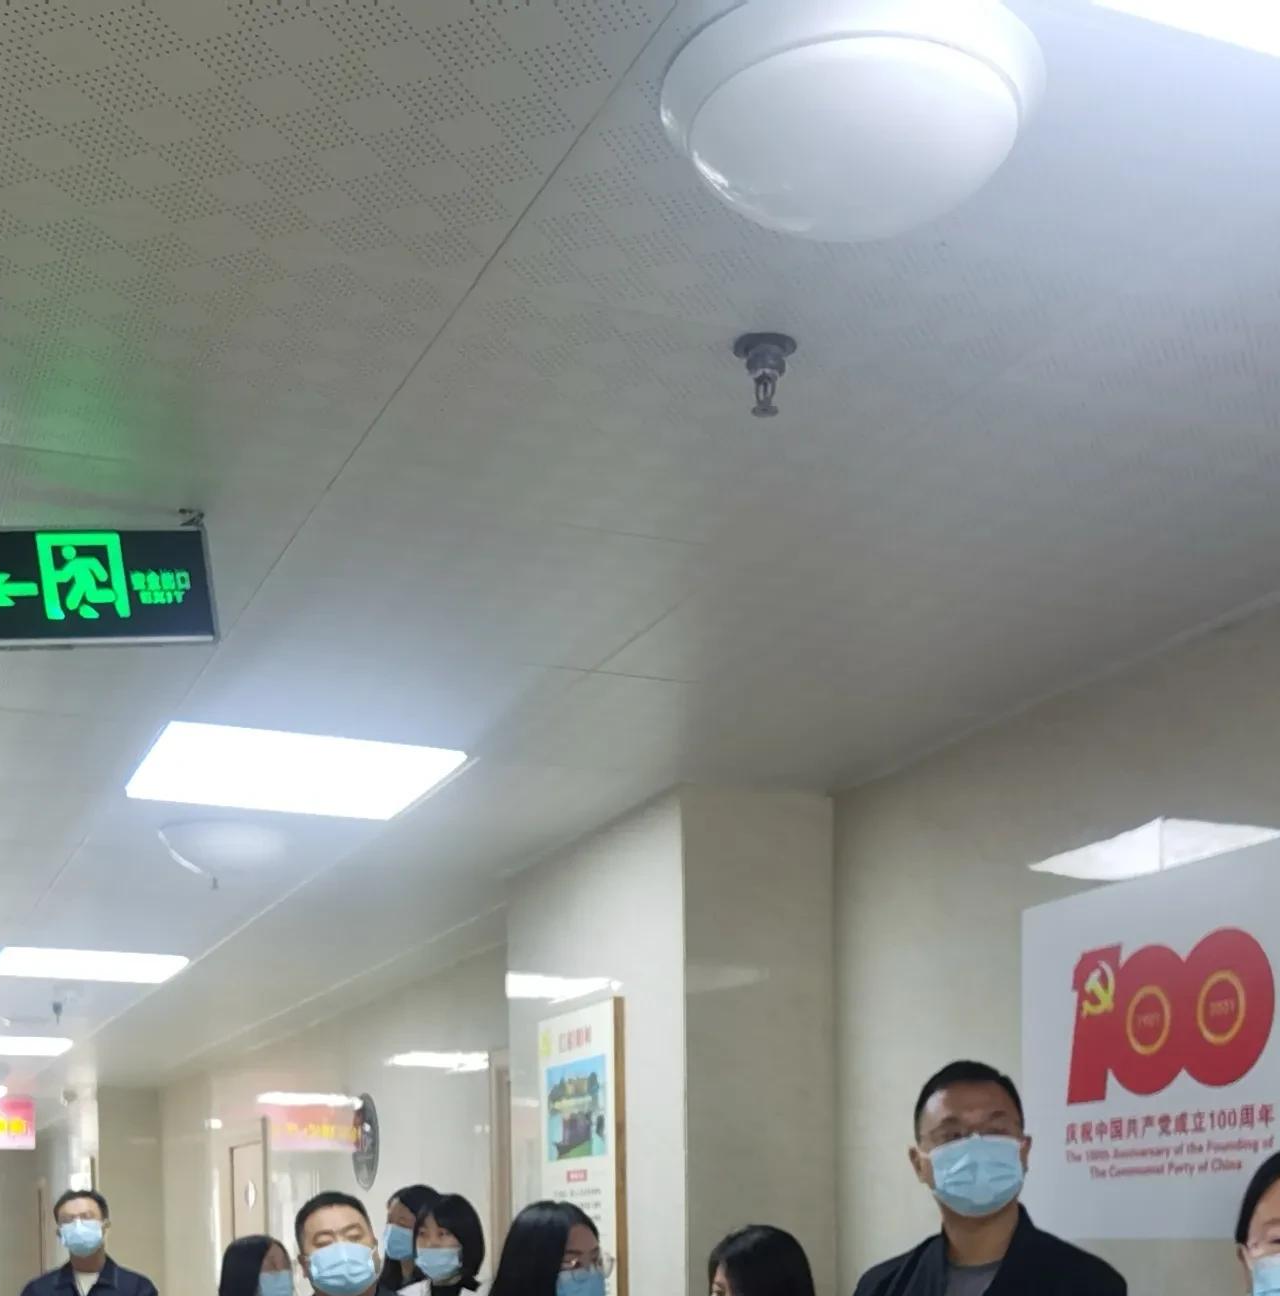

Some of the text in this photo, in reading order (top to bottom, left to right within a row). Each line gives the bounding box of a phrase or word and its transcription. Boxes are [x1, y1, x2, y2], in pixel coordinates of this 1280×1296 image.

[140, 590, 187, 605] EXIT
[1065, 1103, 1276, 1146] 庆祝中国共产党成立100周年
[1211, 1157, 1243, 1172] China
